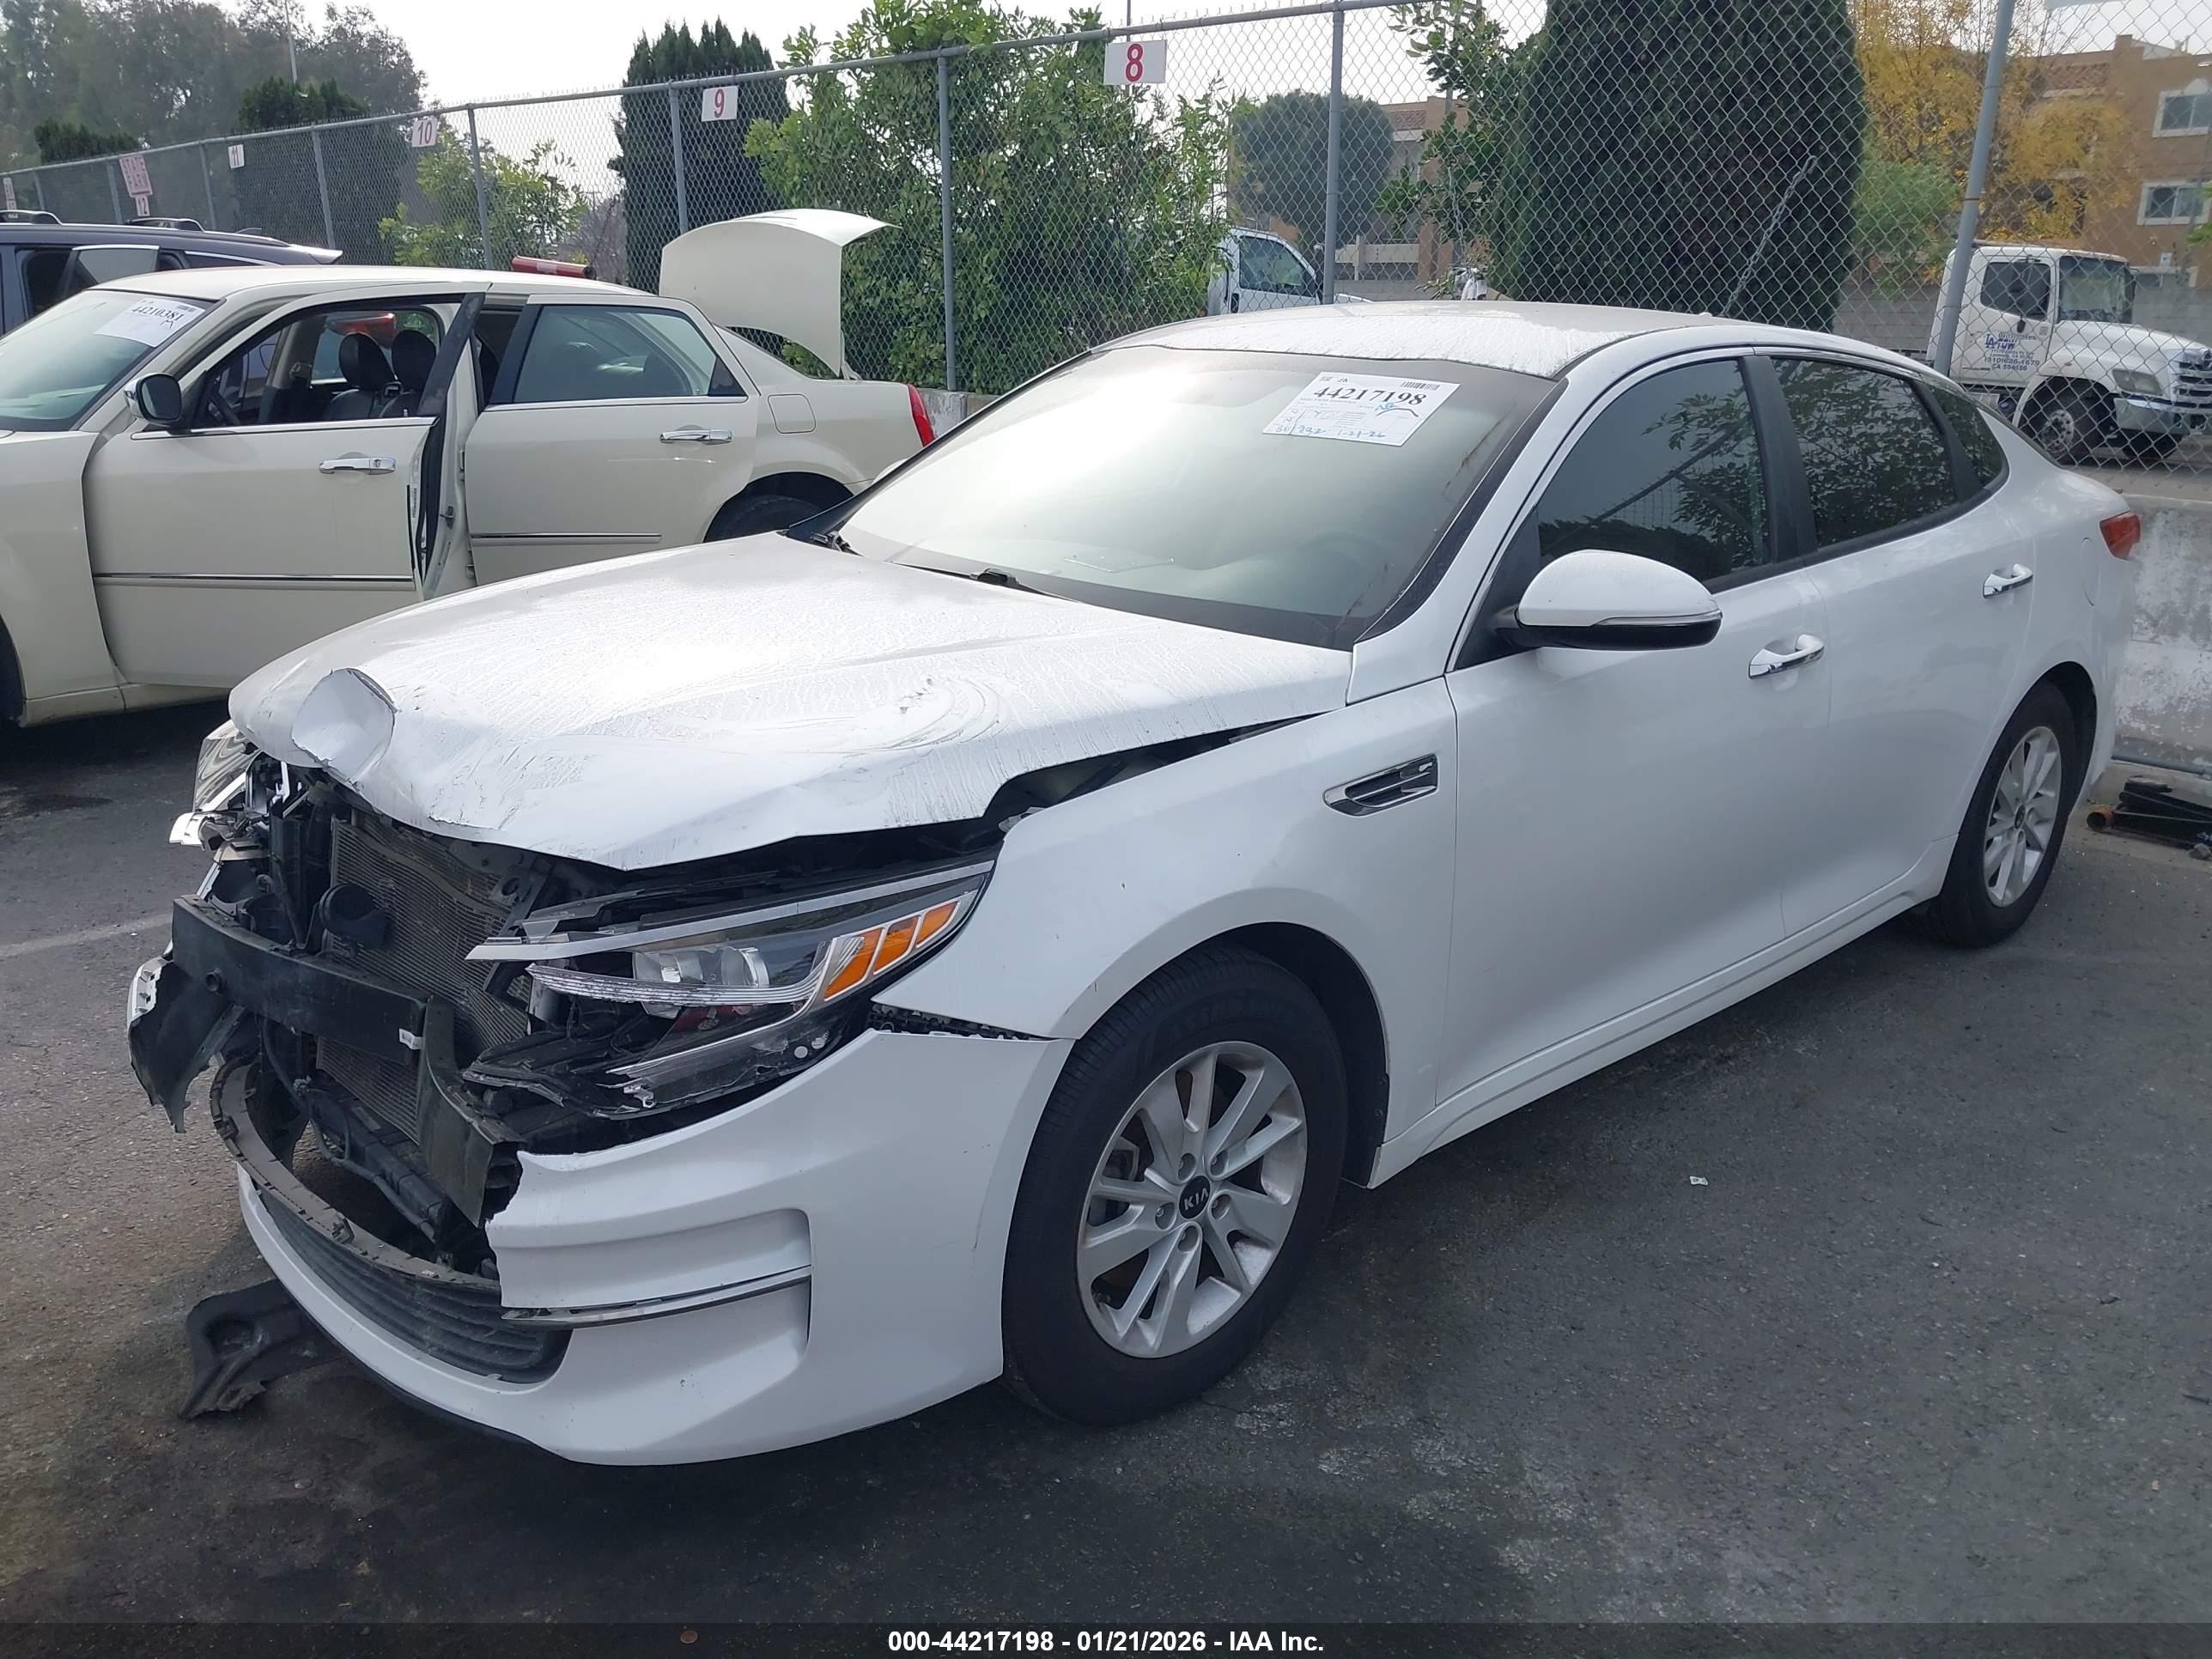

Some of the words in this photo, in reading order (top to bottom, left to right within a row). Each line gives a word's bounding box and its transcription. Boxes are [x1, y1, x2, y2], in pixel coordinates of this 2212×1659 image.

[1126, 43, 1144, 82] 8
[714, 88, 725, 118] 9
[417, 121, 433, 145] 10
[231, 147, 240, 166] 11
[137, 197, 149, 216] 12
[131, 306, 185, 321] 44210381
[1313, 386, 1427, 406] 44217198
[1183, 1188, 1209, 1211] KIA
